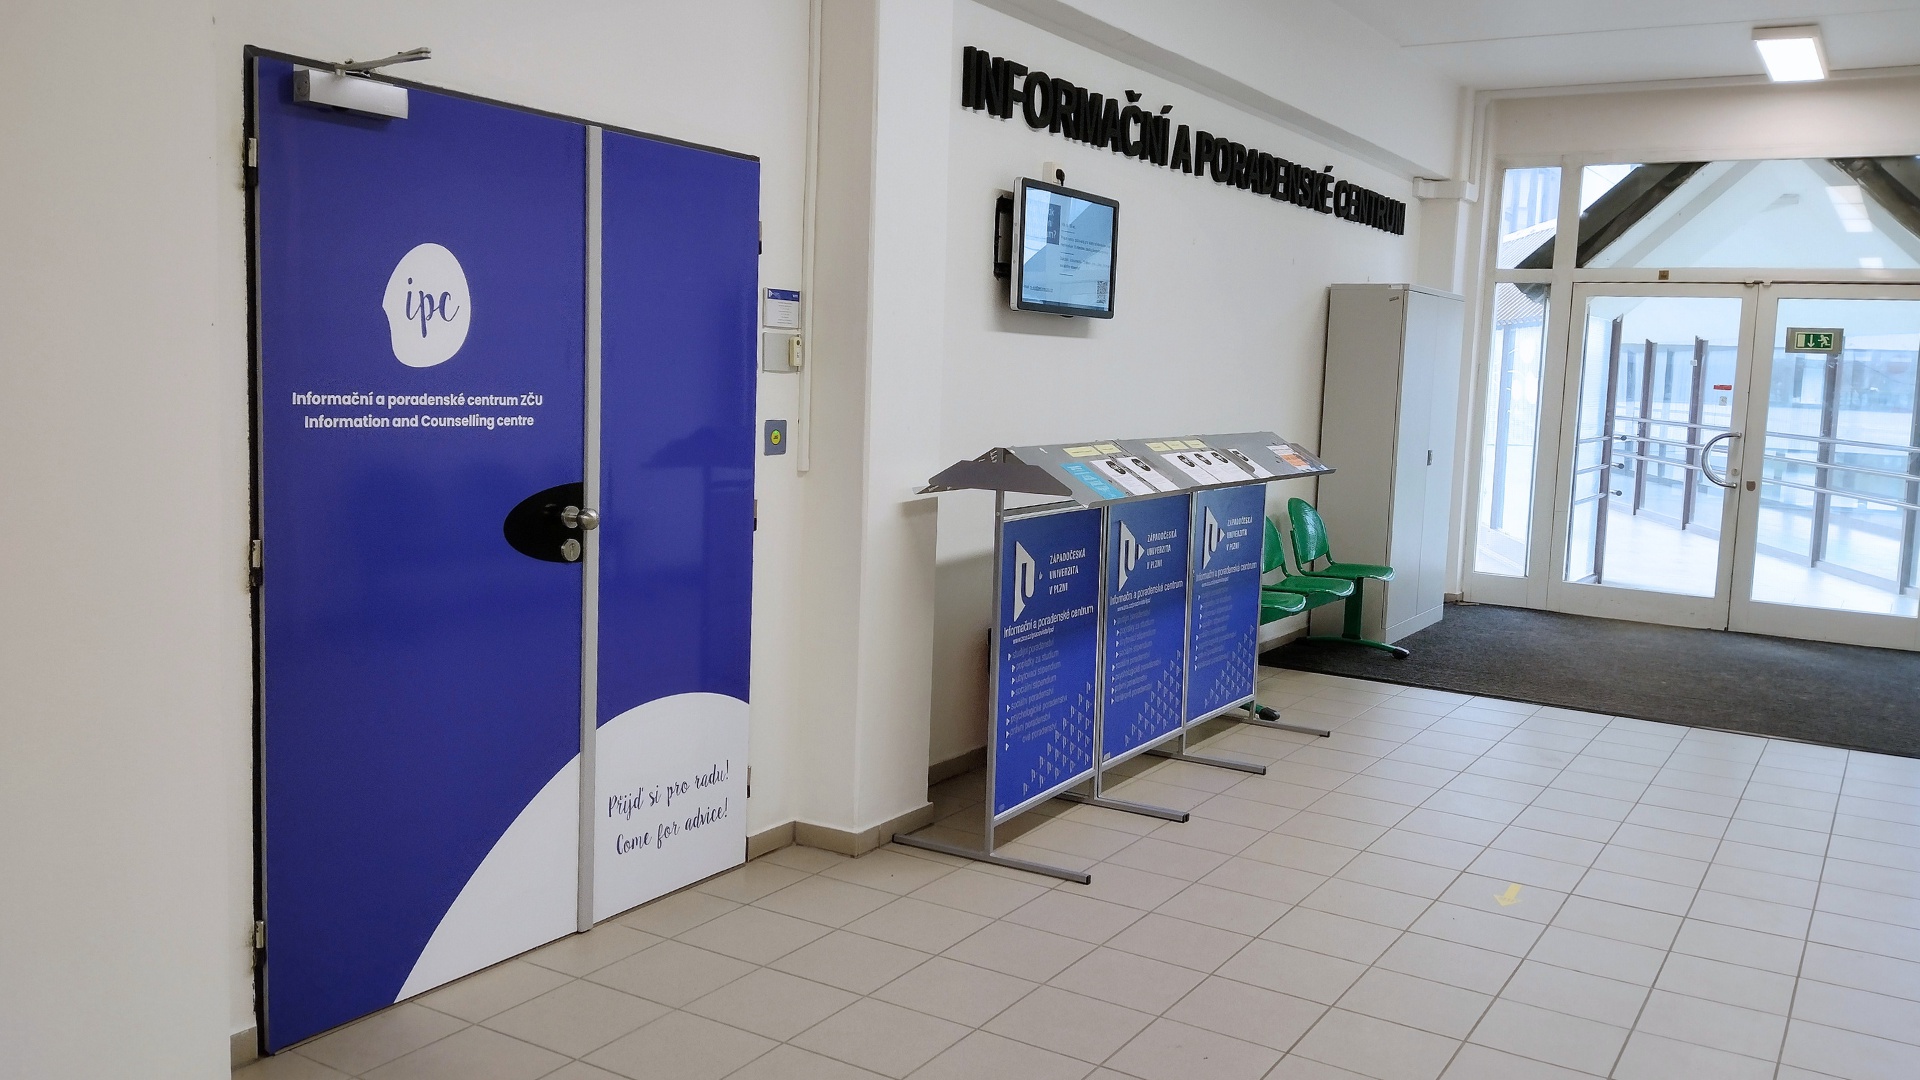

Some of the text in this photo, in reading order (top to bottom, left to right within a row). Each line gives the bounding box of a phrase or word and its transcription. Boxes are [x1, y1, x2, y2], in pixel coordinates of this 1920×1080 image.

[961, 45, 1407, 236] INFORMAČNÍ A PORADENSKÉ CENTRUM
[404, 277, 460, 338] ipc
[292, 391, 543, 409] Informační a poradenské centrum ZČU
[304, 414, 534, 430] Information and Counselling centre
[1147, 529, 1177, 543] ZÁPADOČESKÁ
[1049, 547, 1086, 565] ZÁPADOČESKÁ
[1146, 543, 1171, 557] UNIVERZITA
[1049, 565, 1079, 580] UNIVERZITA
[1049, 582, 1068, 595] V PLZNI
[1003, 605, 1094, 638] Informační a poradenské centrum
[608, 759, 729, 821] Přijď si pro radu!
[616, 797, 729, 855] Come for advice!
